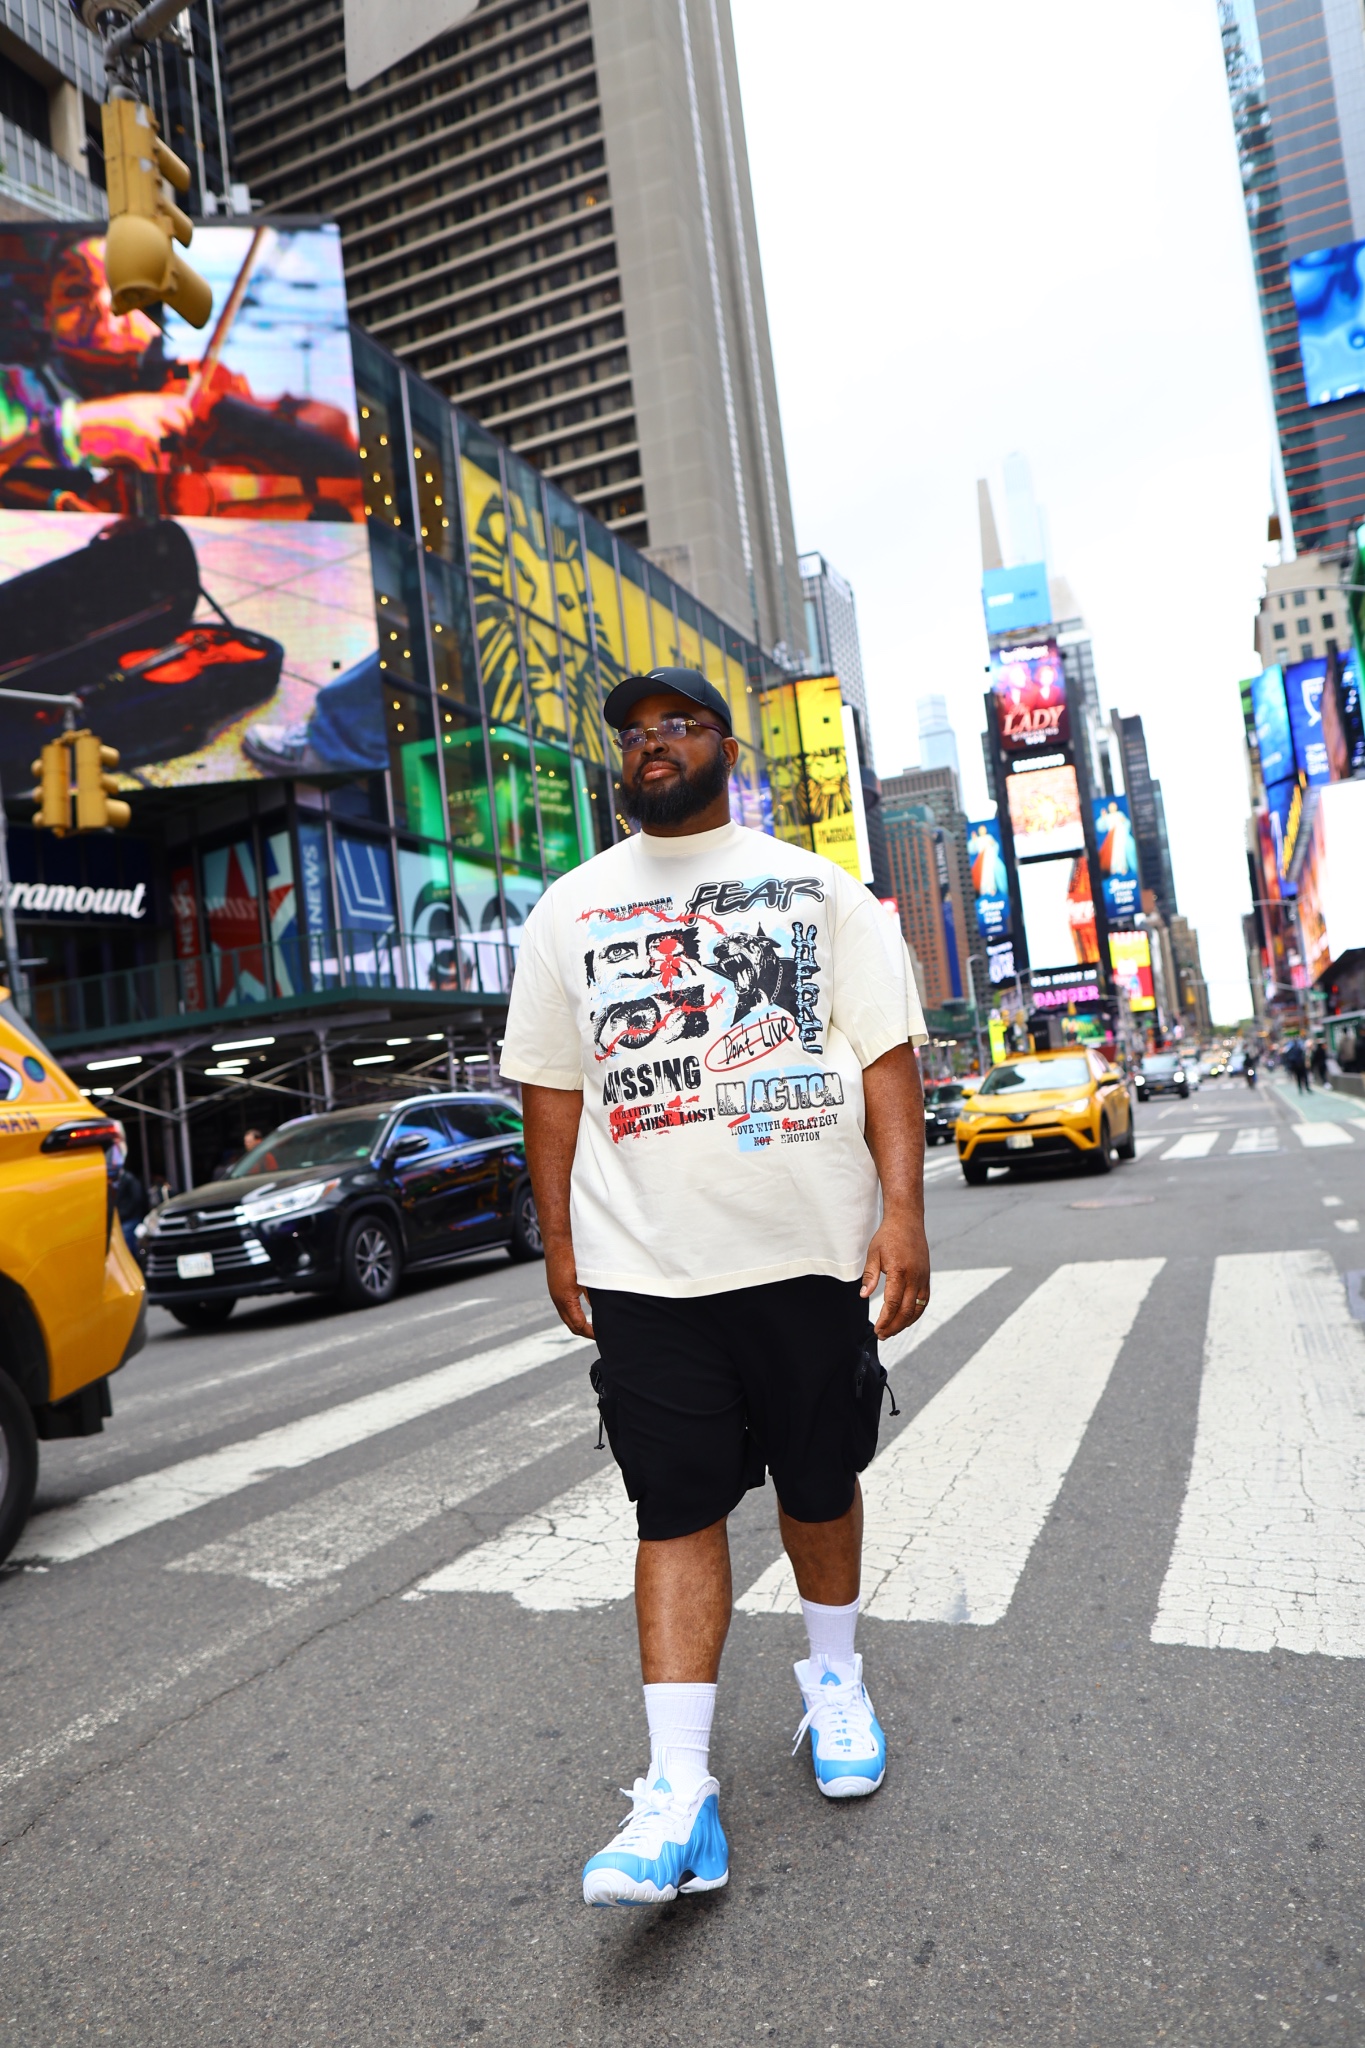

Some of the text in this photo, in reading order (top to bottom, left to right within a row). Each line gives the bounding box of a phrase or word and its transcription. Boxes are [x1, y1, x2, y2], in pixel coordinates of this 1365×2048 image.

[1003, 704, 1066, 736] LADY
[302, 845, 324, 924] NEWS
[684, 877, 824, 927] FEAR
[1032, 985, 1099, 1008] DANGER
[722, 1012, 794, 1065] Don't Live
[603, 1056, 702, 1106] MISSING
[715, 1072, 844, 1116] IN ACTION
[616, 1107, 716, 1136] PARADISE LOST
[653, 1102, 666, 1114] BY
[755, 1120, 780, 1133] WITH
[785, 1113, 839, 1133] STRATEGY
[753, 1136, 772, 1147] NOT
